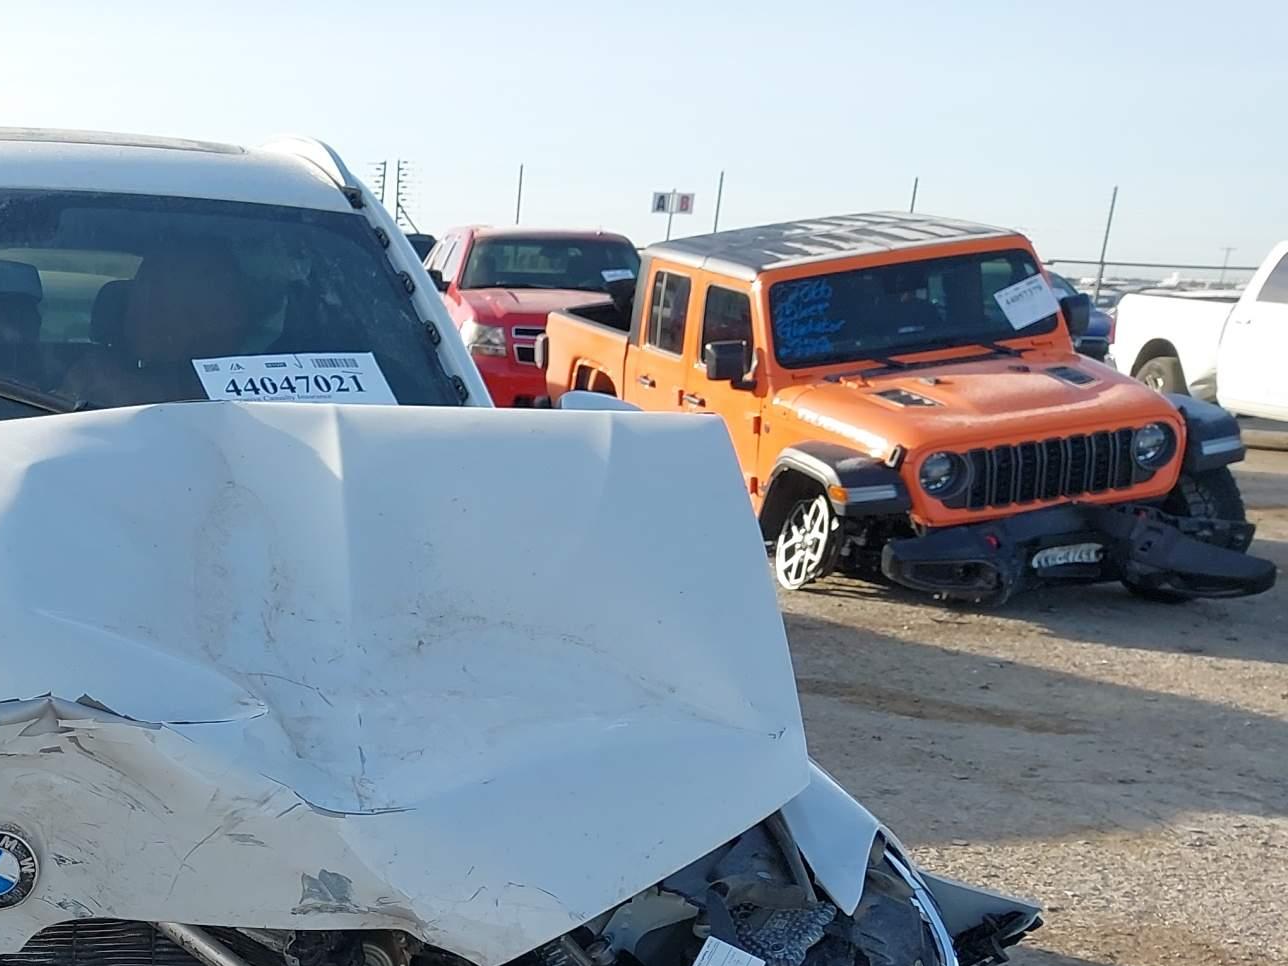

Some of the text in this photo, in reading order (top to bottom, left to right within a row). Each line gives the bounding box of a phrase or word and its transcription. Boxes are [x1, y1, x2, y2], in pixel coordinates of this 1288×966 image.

[656, 195, 665, 211] A
[679, 195, 690, 211] B
[225, 374, 367, 397] 44047021
